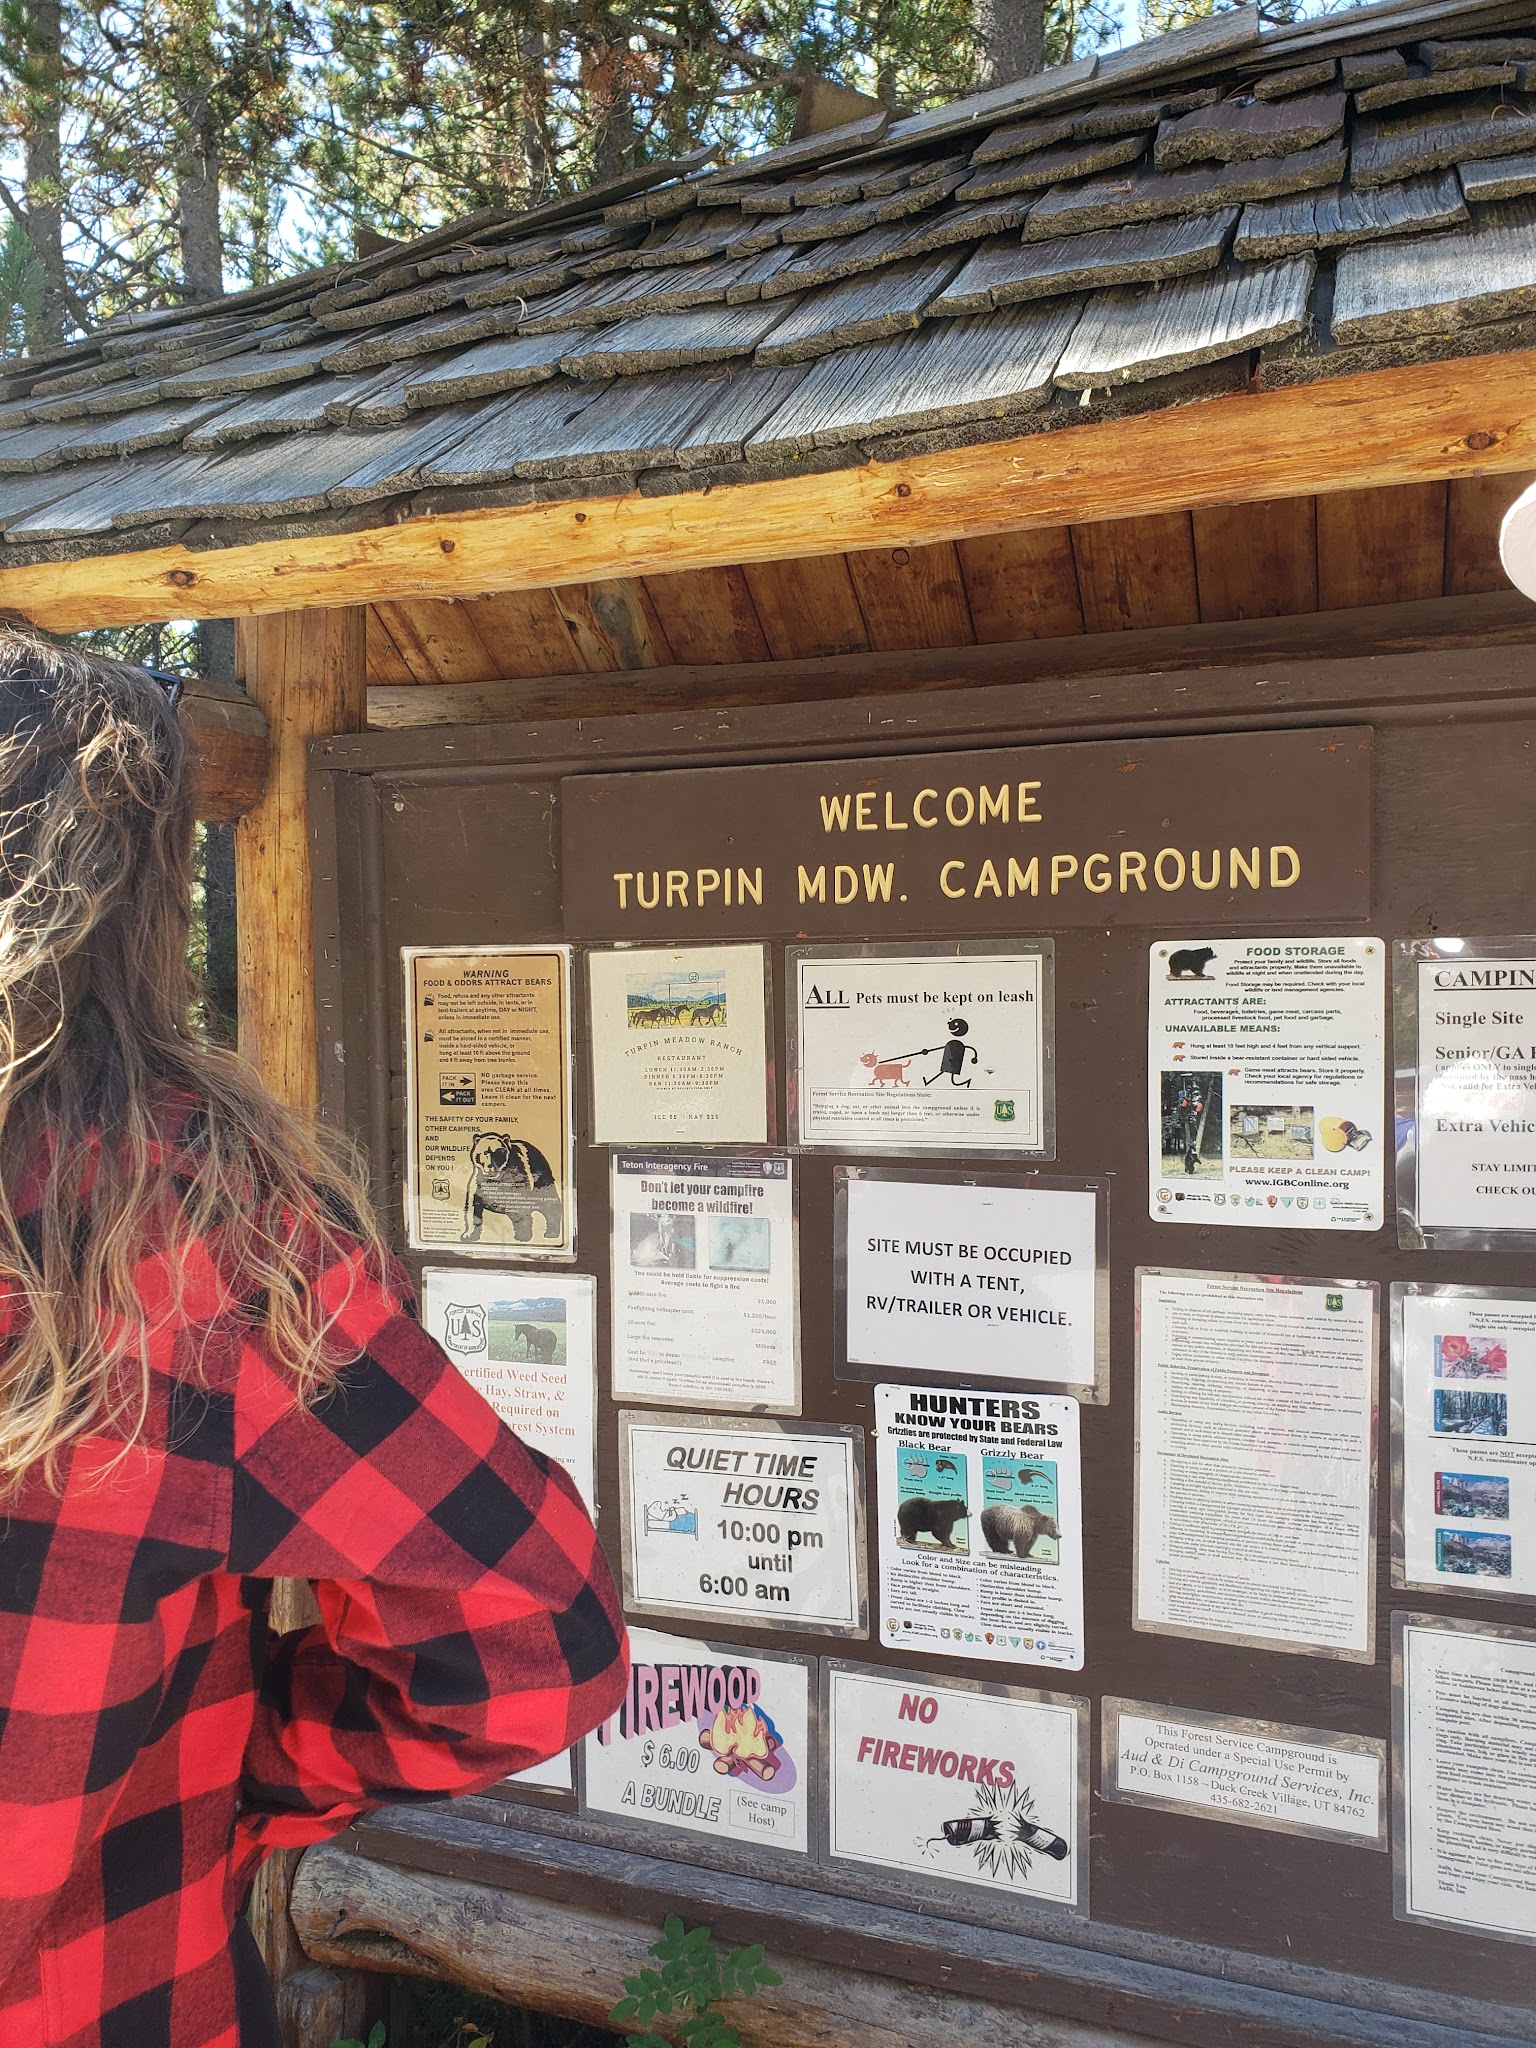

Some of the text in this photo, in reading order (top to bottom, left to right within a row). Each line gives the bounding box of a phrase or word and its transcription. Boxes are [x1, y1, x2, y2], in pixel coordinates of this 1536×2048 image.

[819, 780, 1044, 834] WELCOME
[613, 844, 1302, 911] TURPIN MDW. CAMPGROUND
[1246, 946, 1345, 956] FOOD STORAGE
[463, 970, 510, 978] WARNING
[805, 984, 1034, 1006] ALL Pets must be kept on leash
[1165, 997, 1267, 1007] ATTRACTANTS ARE:
[1165, 1024, 1281, 1034] UNAVAILABLE MEANS:
[1435, 1011, 1524, 1029] Single Site
[624, 1040, 659, 1058] TURPIN
[710, 1039, 743, 1056] RANCH
[1436, 1046, 1525, 1060] Senior/GA
[1436, 1119, 1483, 1132] Extra
[622, 1161, 708, 1173] Teton Interagency Fire
[1229, 1166, 1370, 1177] PLEASE KEEP A CLEAN CAMP!
[1472, 1164, 1500, 1172] STAY
[641, 1181, 764, 1198] Don't let your campfire
[1245, 1178, 1350, 1190] www.IGBConline.org
[1476, 1186, 1518, 1195] CHECK
[652, 1199, 753, 1214] become a wildfire!
[867, 1238, 1072, 1265] SITE MUST BE OCCUPIED
[911, 1270, 1026, 1295] WITH A TENT,
[866, 1296, 1073, 1326] RV/TRAILER OR VEHICLE.
[507, 1369, 538, 1382] Weed
[541, 1372, 567, 1385] Seed
[486, 1385, 565, 1402] Hay, Straw, &
[492, 1402, 560, 1418] Required on
[910, 1393, 1041, 1420] HUNTERS
[536, 1422, 575, 1436] System
[895, 1413, 1059, 1436] KNOW YOUR BEARS
[887, 1427, 1063, 1448] Grizzlies are protected by State and Federal Law
[898, 1440, 952, 1453] Black Bear
[666, 1446, 818, 1478] QUIET TIME
[981, 1448, 1044, 1460] Grizzly Bear
[723, 1482, 820, 1511] HOURS
[717, 1520, 824, 1550] 10:00 pm
[749, 1554, 793, 1573] until
[700, 1574, 790, 1601] 6:00 am
[598, 1664, 761, 1747] IREWOOD
[898, 1694, 939, 1724] NO
[1156, 1725, 1337, 1765] This Forest Service Campground is
[641, 1741, 701, 1773] $ 6.00
[857, 1736, 1016, 1789] FIREWORKS
[1144, 1737, 1350, 1783] Operated under a Special Use Permit by
[1121, 1749, 1374, 1805] Aud & Di Campground Services, Inc.
[622, 1781, 721, 1822] A BUNDLE
[1130, 1766, 1366, 1818] P.O. Box 1158 Duck Creek Village, UT 84762
[736, 1794, 787, 1815] (See camp
[1210, 1794, 1279, 1815] 435-682-2621
[748, 1813, 775, 1828] Host)
